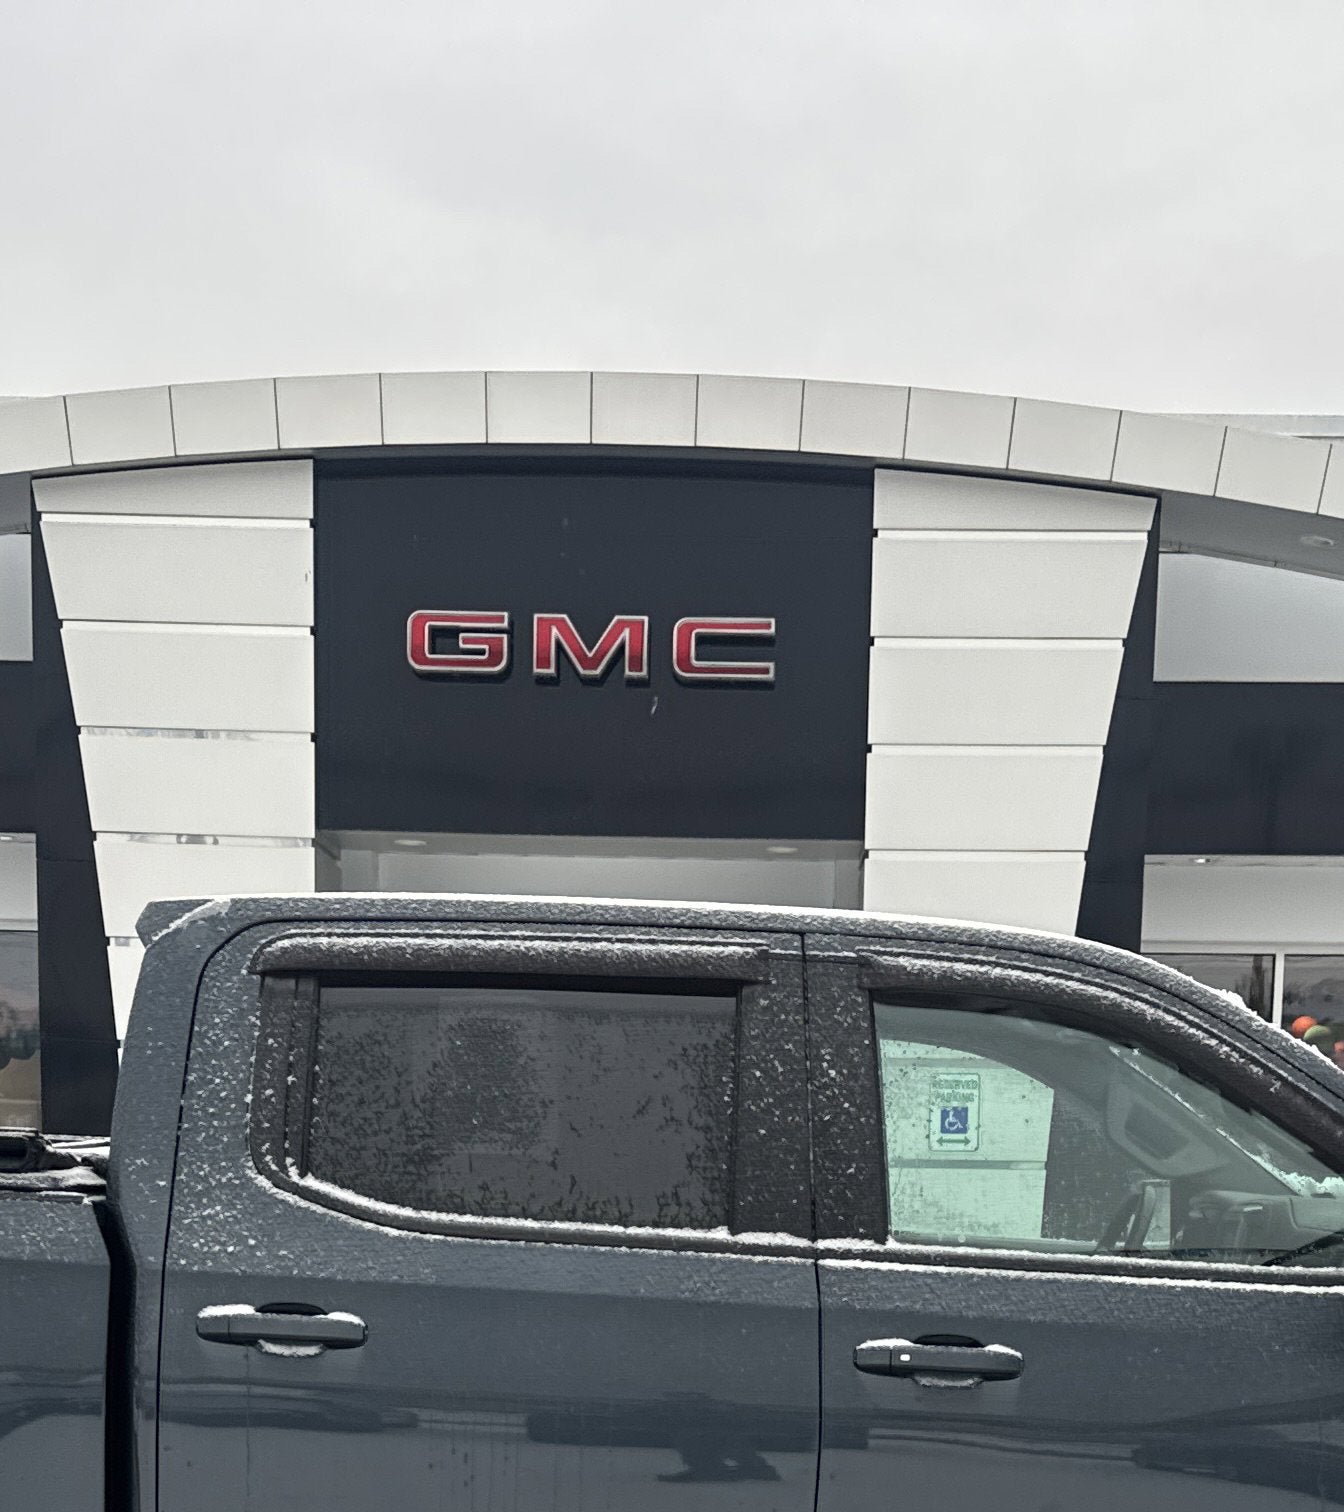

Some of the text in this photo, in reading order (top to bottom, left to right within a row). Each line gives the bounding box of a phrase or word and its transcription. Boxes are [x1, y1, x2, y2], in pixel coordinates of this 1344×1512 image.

[407, 609, 776, 682] GMC
[932, 1079, 978, 1090] RESERVED
[934, 1091, 975, 1103] PARKING
